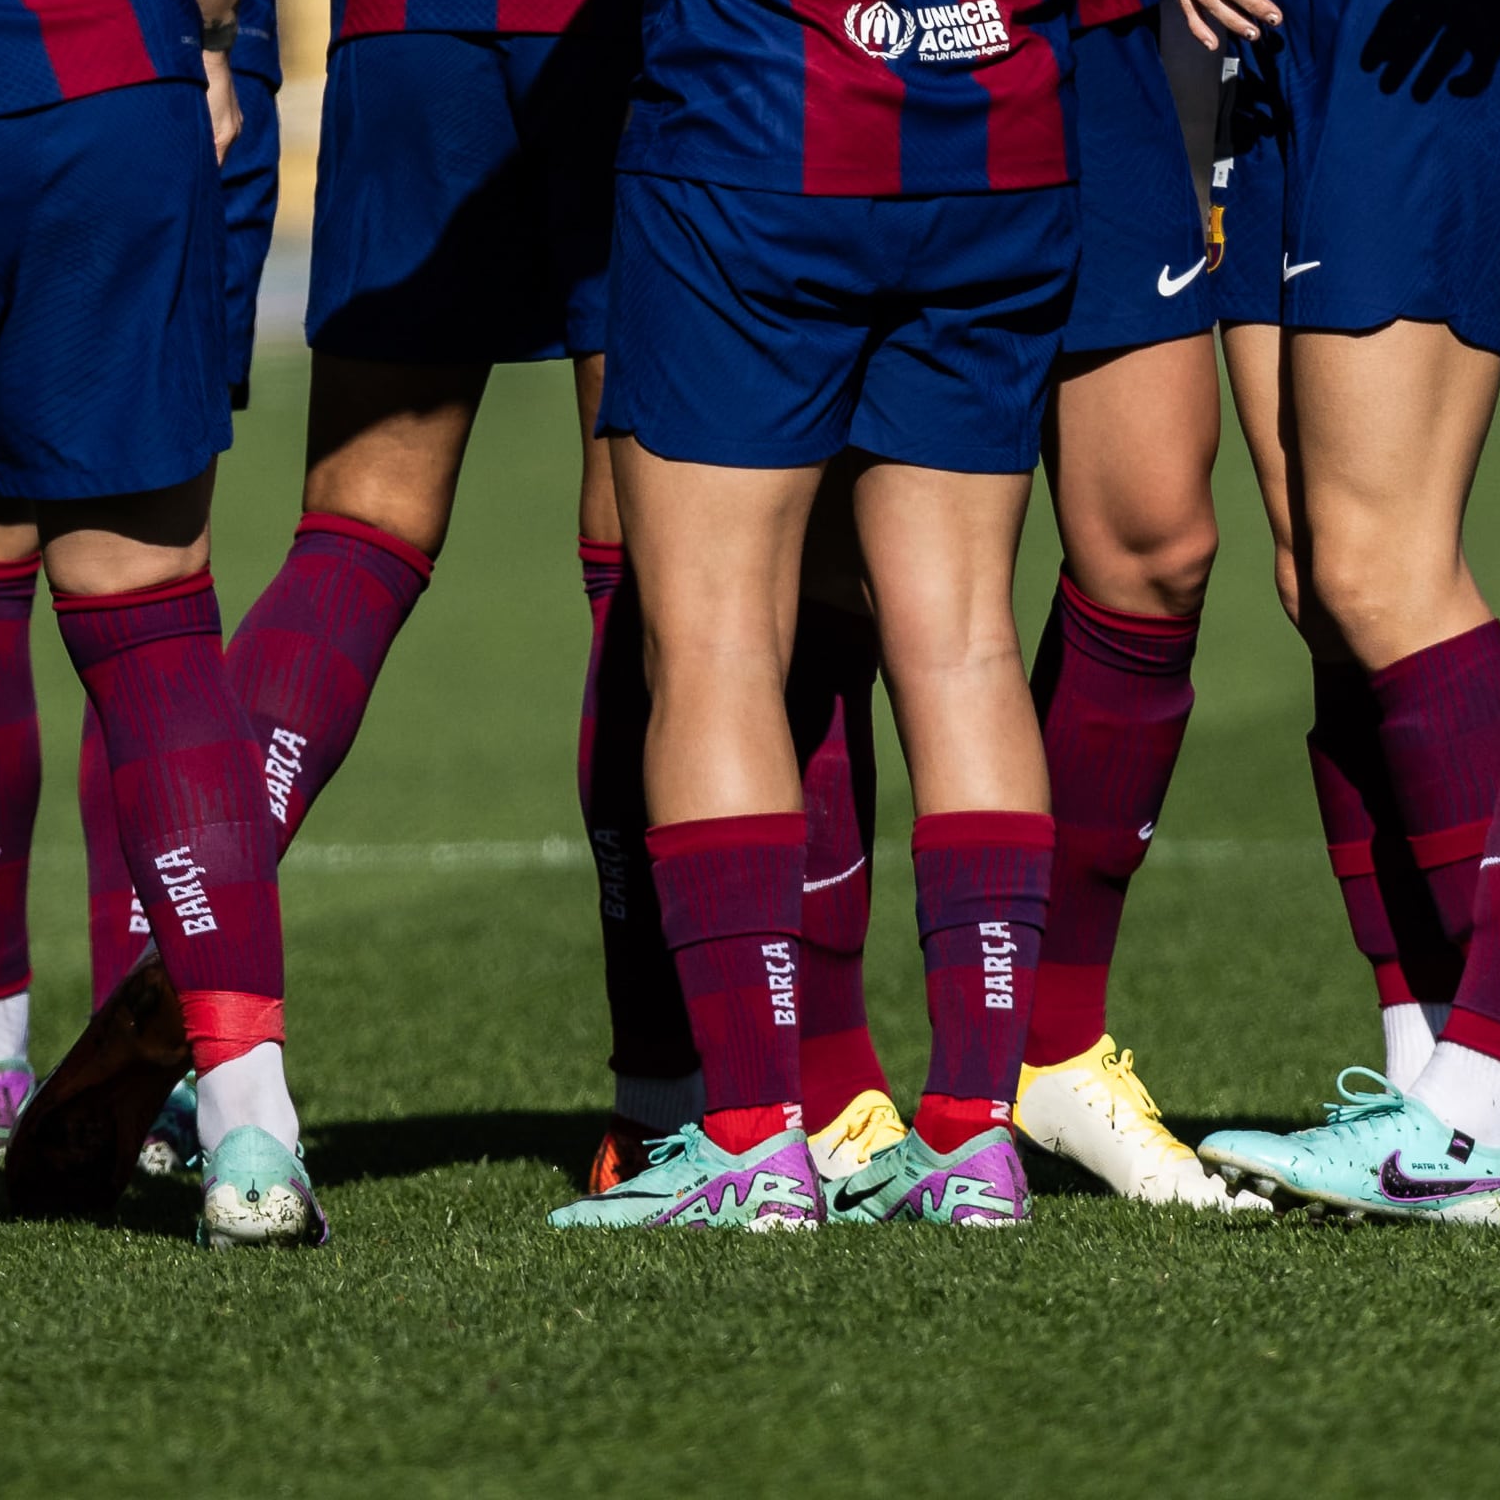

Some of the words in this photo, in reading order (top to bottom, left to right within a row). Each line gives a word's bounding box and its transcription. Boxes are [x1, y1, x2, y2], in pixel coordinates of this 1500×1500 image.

[917, 20, 1009, 52] ACNUR
[919, 52, 936, 62] The
[936, 51, 950, 61] UN
[950, 48, 982, 61] Refugee
[980, 41, 1011, 57] Agency
[264, 726, 308, 825] BARÇA
[154, 845, 218, 937] BARÇA
[761, 941, 797, 1026] BARÇA
[978, 921, 1018, 1010] BARÇA
[1411, 1162, 1437, 1171] PATRI
[1438, 1162, 1450, 1171] 12
